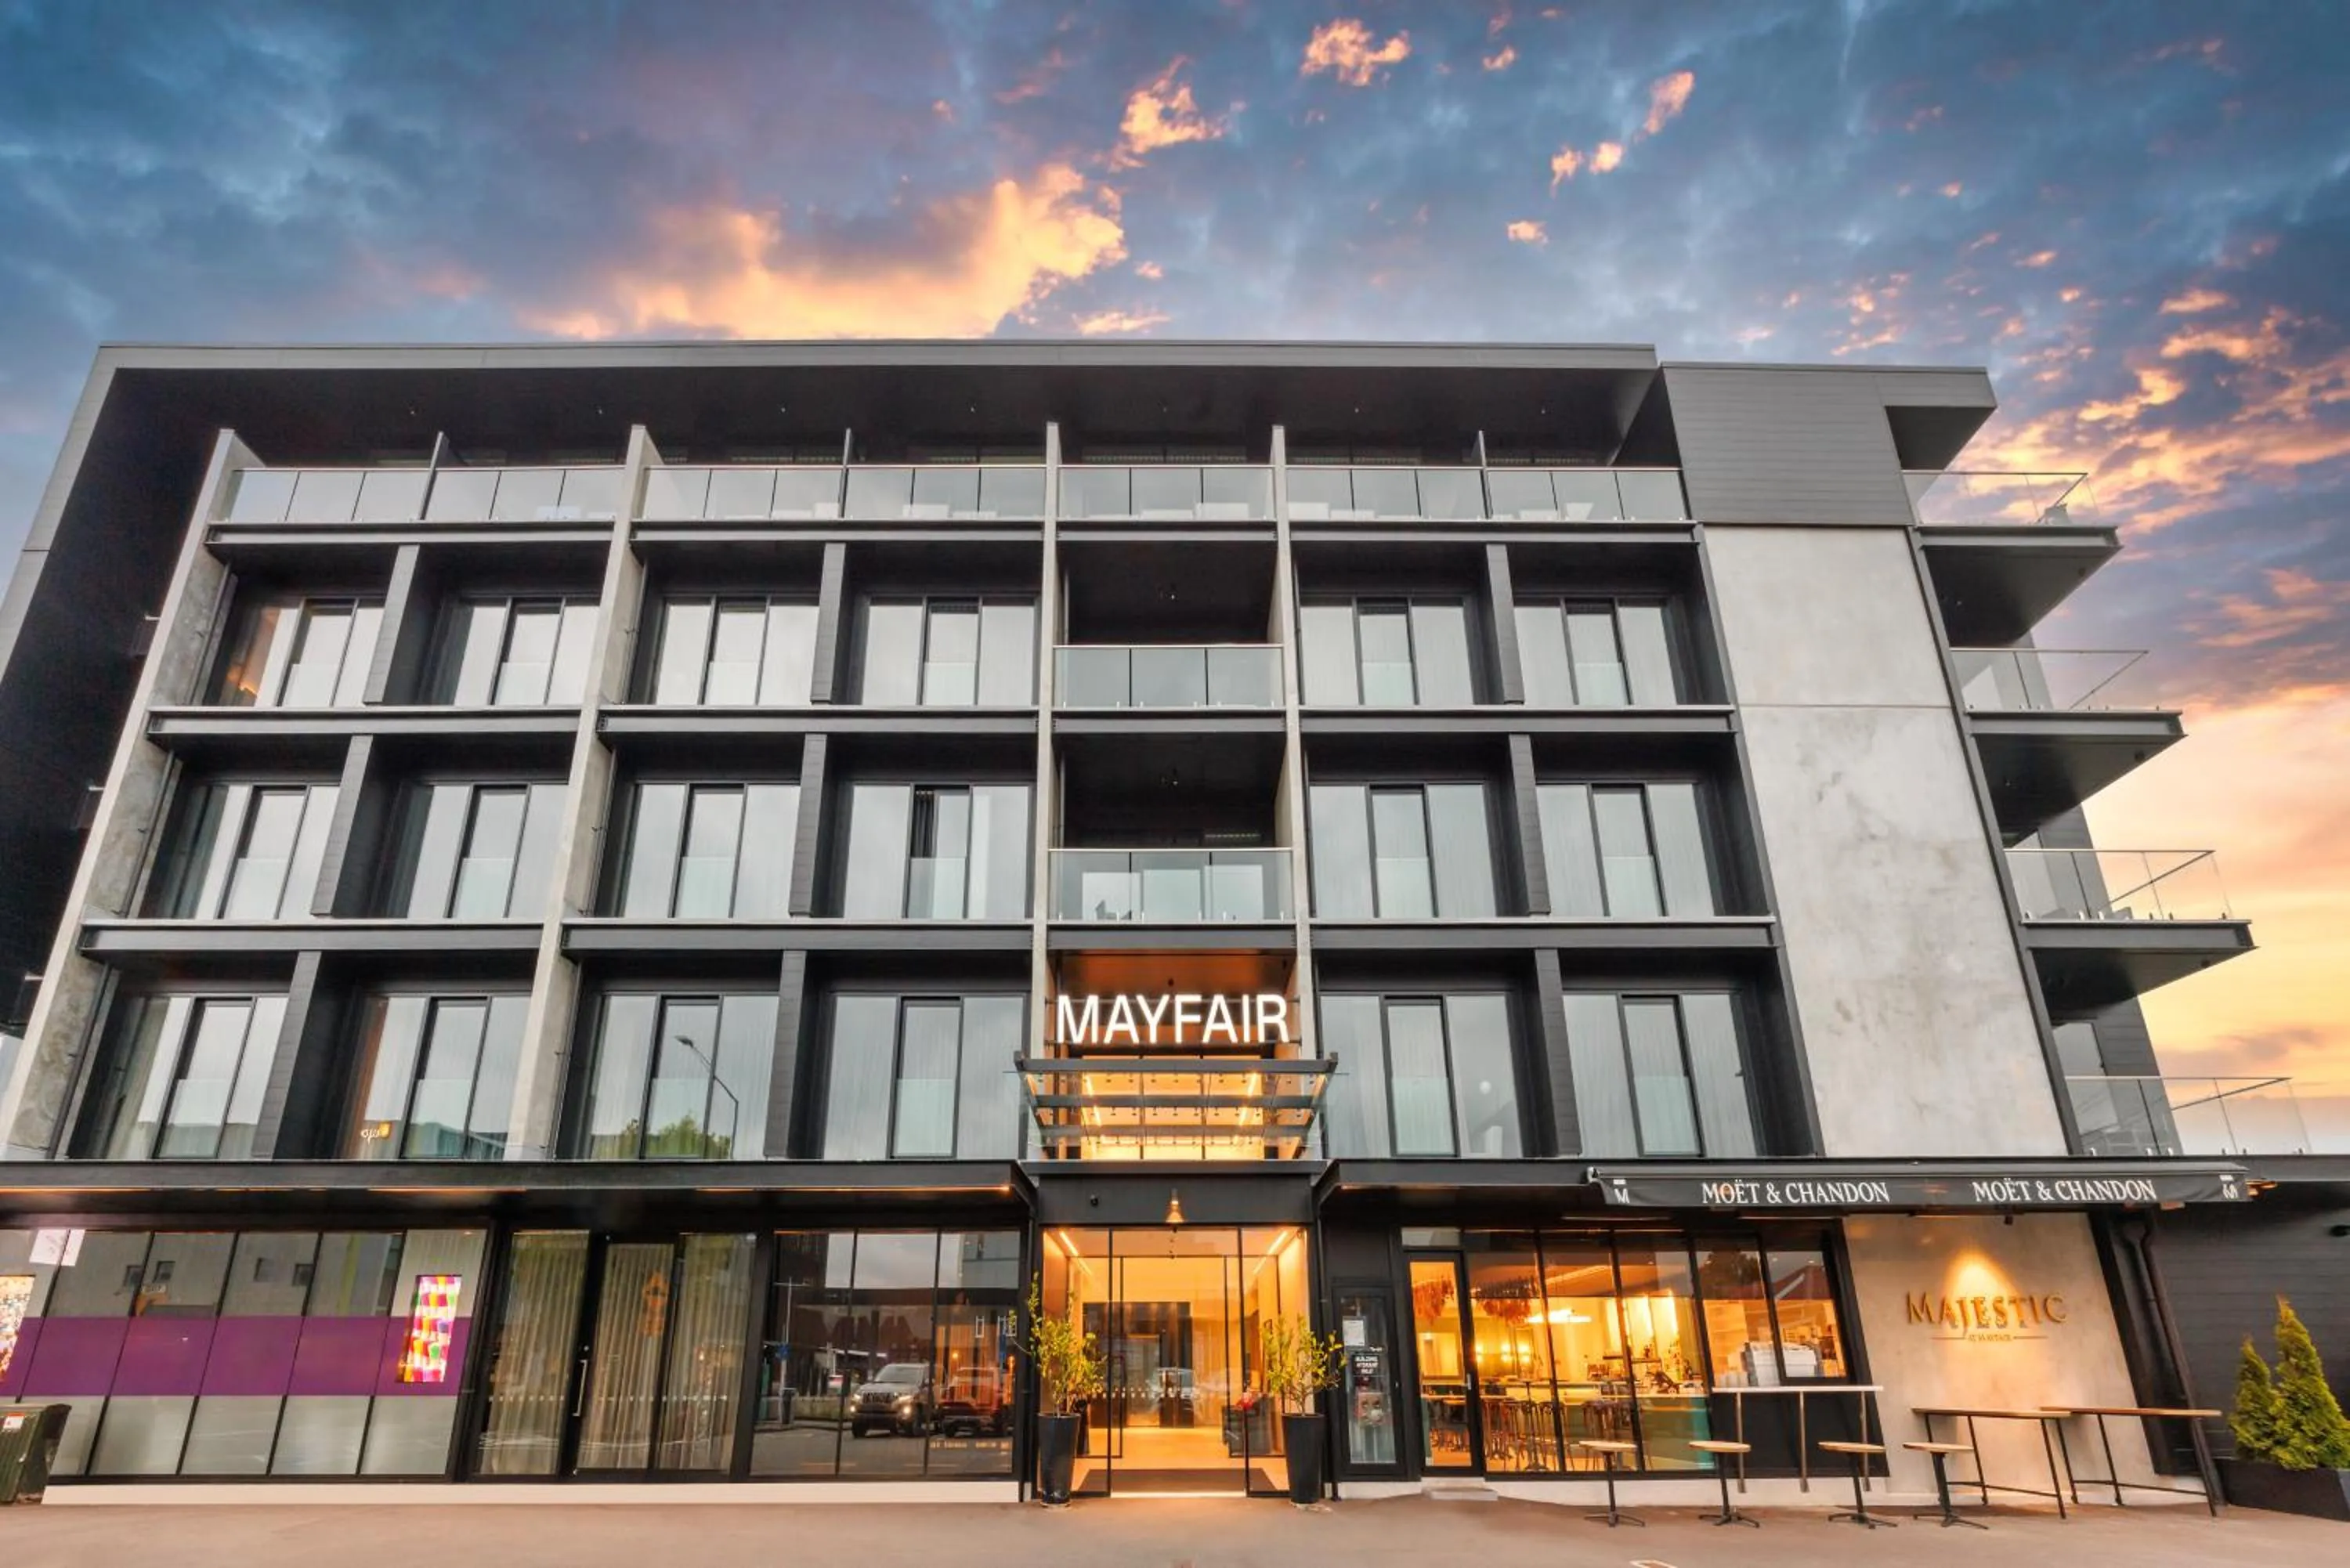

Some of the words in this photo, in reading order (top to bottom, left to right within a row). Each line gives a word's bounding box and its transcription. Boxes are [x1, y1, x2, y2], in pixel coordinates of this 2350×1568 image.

[1057, 993, 1290, 1043] MAYFAIR
[1701, 1179, 1760, 1204] MOËT
[1766, 1182, 1781, 1203] &
[1785, 1181, 1890, 1203] CHANDON
[1972, 1177, 2032, 1201] MOËT
[2036, 1180, 2054, 1201] &
[2055, 1179, 2157, 1201] CHANDON
[1906, 1292, 2068, 1329] MAJESTIC
